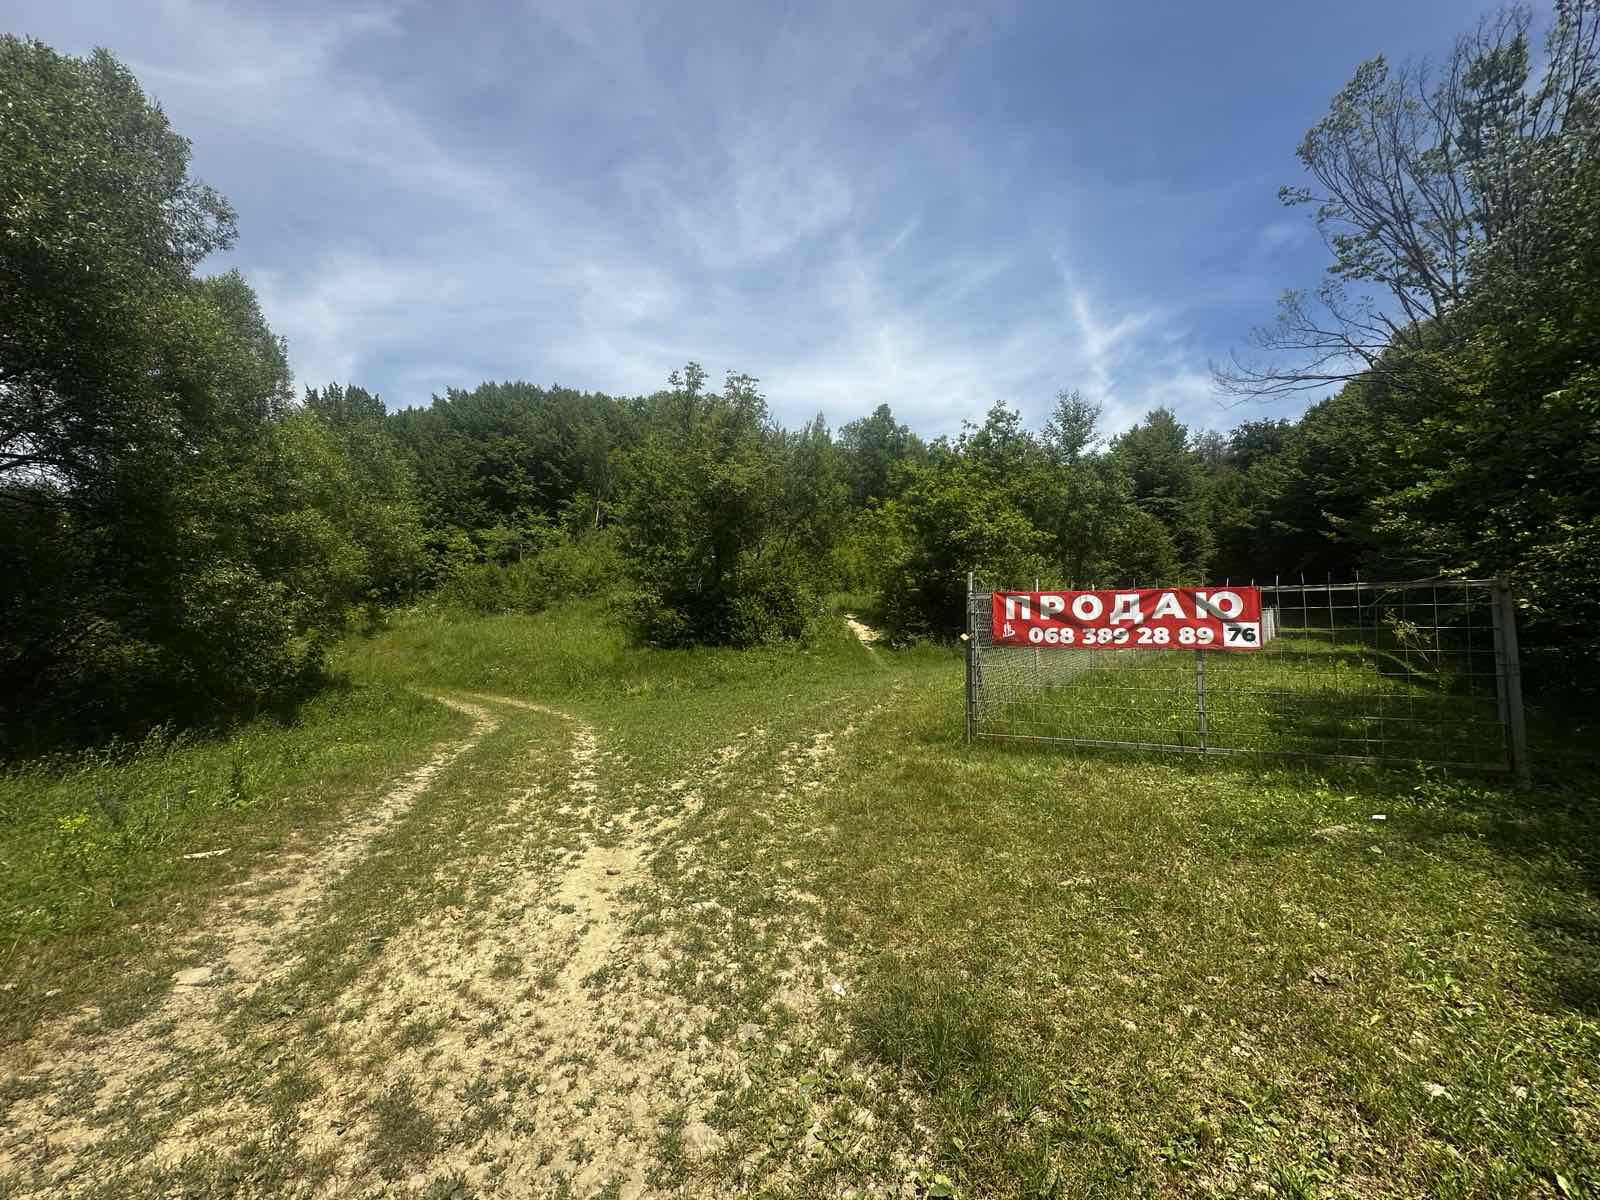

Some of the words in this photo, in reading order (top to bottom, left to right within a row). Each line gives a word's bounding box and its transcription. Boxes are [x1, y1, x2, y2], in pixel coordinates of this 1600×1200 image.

[1005, 591, 1244, 624] ПРОДАЮ
[1028, 627, 1075, 644] 068
[1081, 627, 1130, 644] 389
[1136, 627, 1170, 644] 28
[1178, 627, 1214, 644] 89
[1228, 627, 1256, 642] 76
